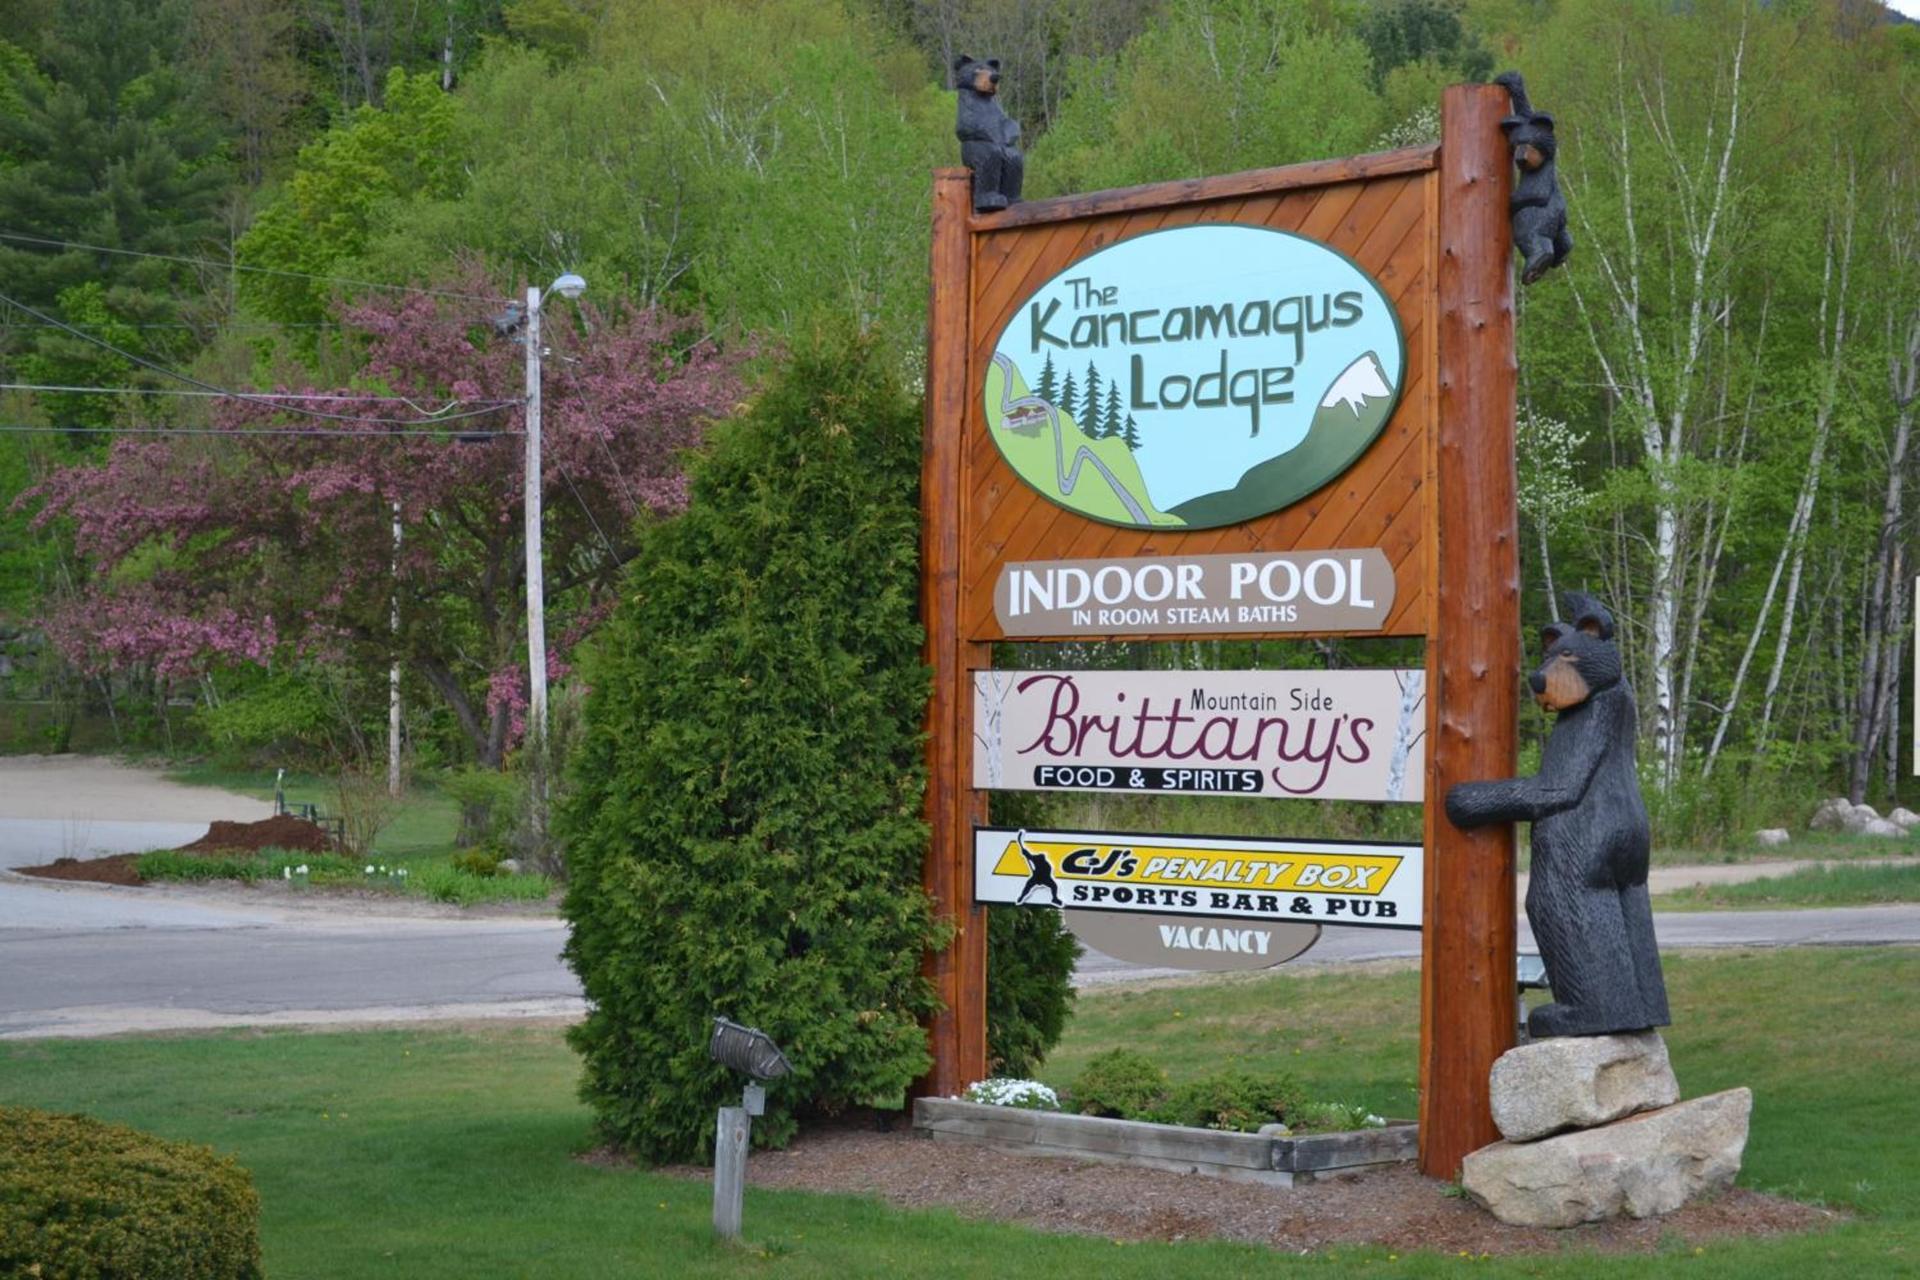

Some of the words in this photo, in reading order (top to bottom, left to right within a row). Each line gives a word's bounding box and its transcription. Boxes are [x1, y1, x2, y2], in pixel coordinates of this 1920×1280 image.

[1064, 277, 1119, 310] The
[1130, 348, 1295, 438] Lodge
[1009, 564, 1206, 617] INDOOR
[1230, 557, 1375, 609] POOL
[1073, 609, 1092, 626] IN
[1098, 608, 1160, 625] ROOM
[1167, 606, 1230, 625] STEAM
[1238, 604, 1298, 623] BATHS
[1190, 687, 1277, 712] Mountain
[1290, 687, 1334, 712] Side
[1016, 673, 1375, 795] Brittany's
[1040, 767, 1116, 787] FOOD
[1128, 769, 1146, 788] &
[1162, 770, 1257, 792] SPIRITS
[1141, 856, 1295, 886] PENALTY
[1294, 863, 1383, 890] BOX
[1073, 885, 1198, 908] SPORTS
[1210, 892, 1280, 913] BAR
[1289, 896, 1313, 915] &
[1325, 898, 1398, 918] PUB
[1158, 925, 1272, 954] VACANCY
